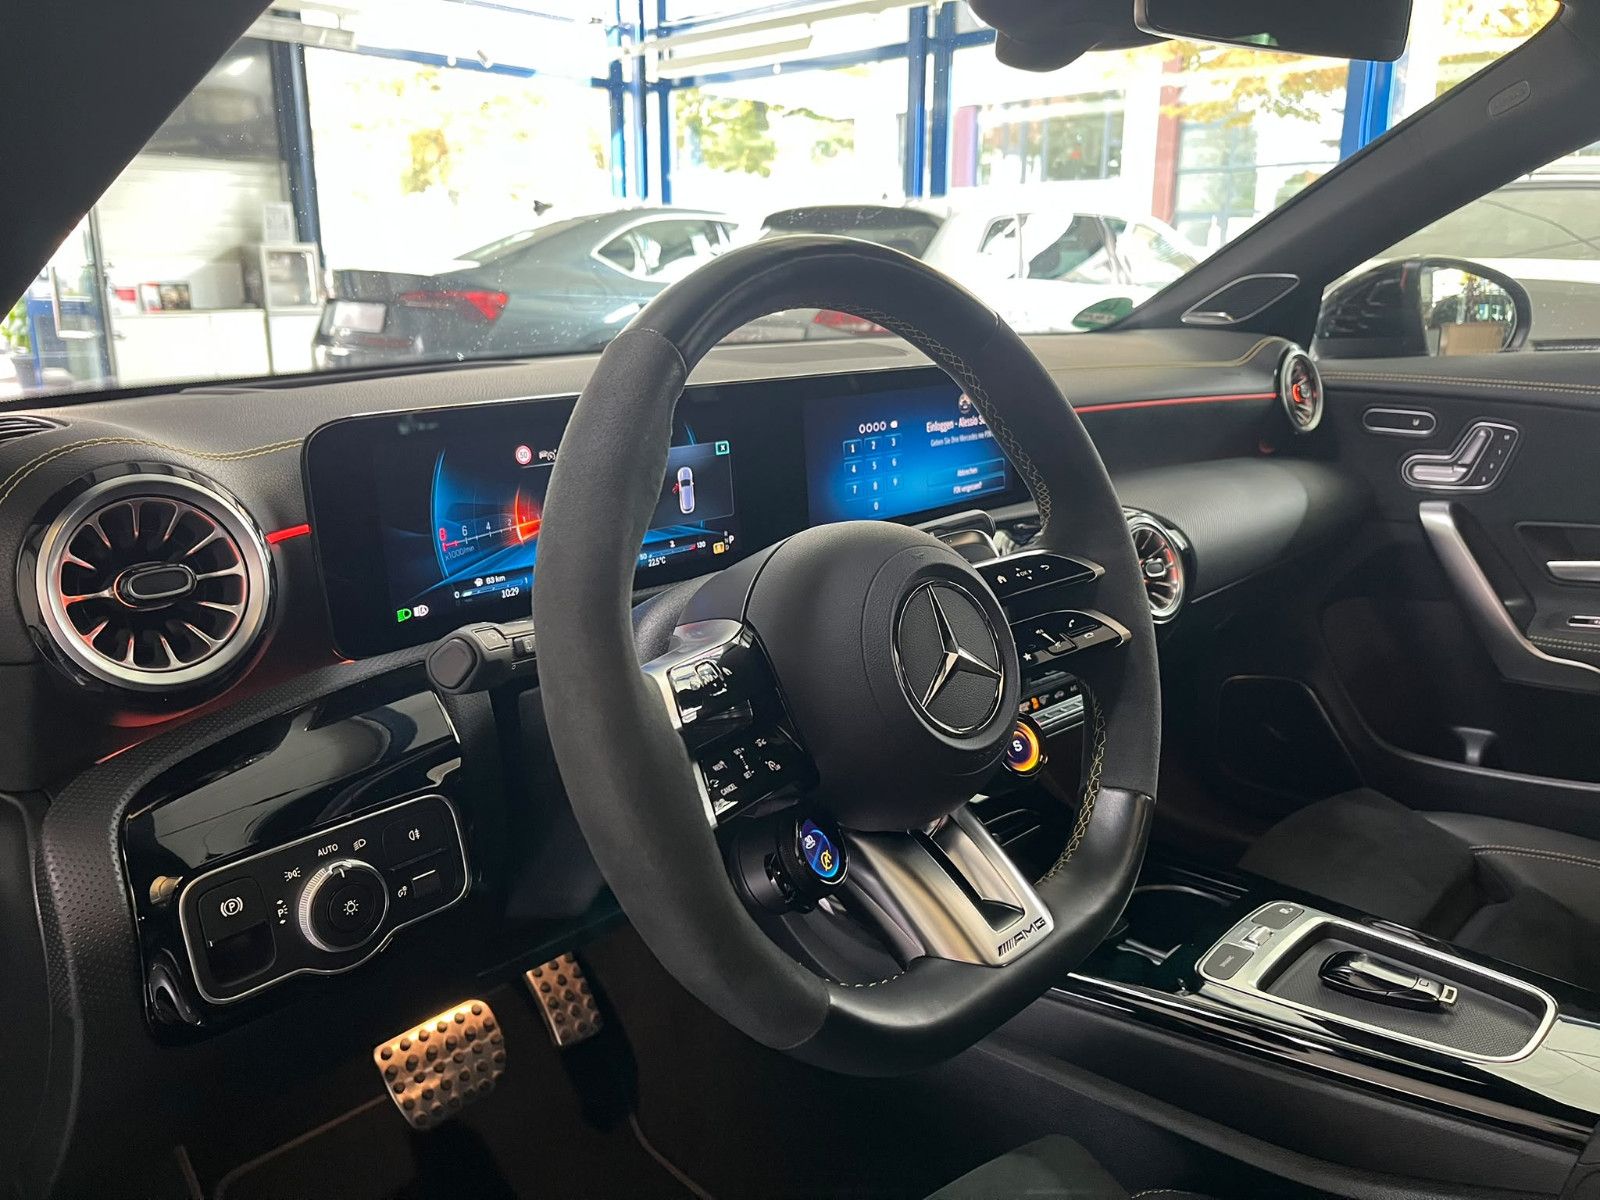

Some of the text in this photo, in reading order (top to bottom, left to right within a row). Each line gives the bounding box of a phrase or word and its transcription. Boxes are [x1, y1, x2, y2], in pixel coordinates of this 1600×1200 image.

[871, 440, 876, 450] 2
[461, 525, 468, 537] 6
[485, 521, 491, 531] 4
[507, 518, 512, 526] 2
[728, 534, 735, 544] P
[1012, 739, 1023, 752] S
[317, 843, 339, 857] AUTO
